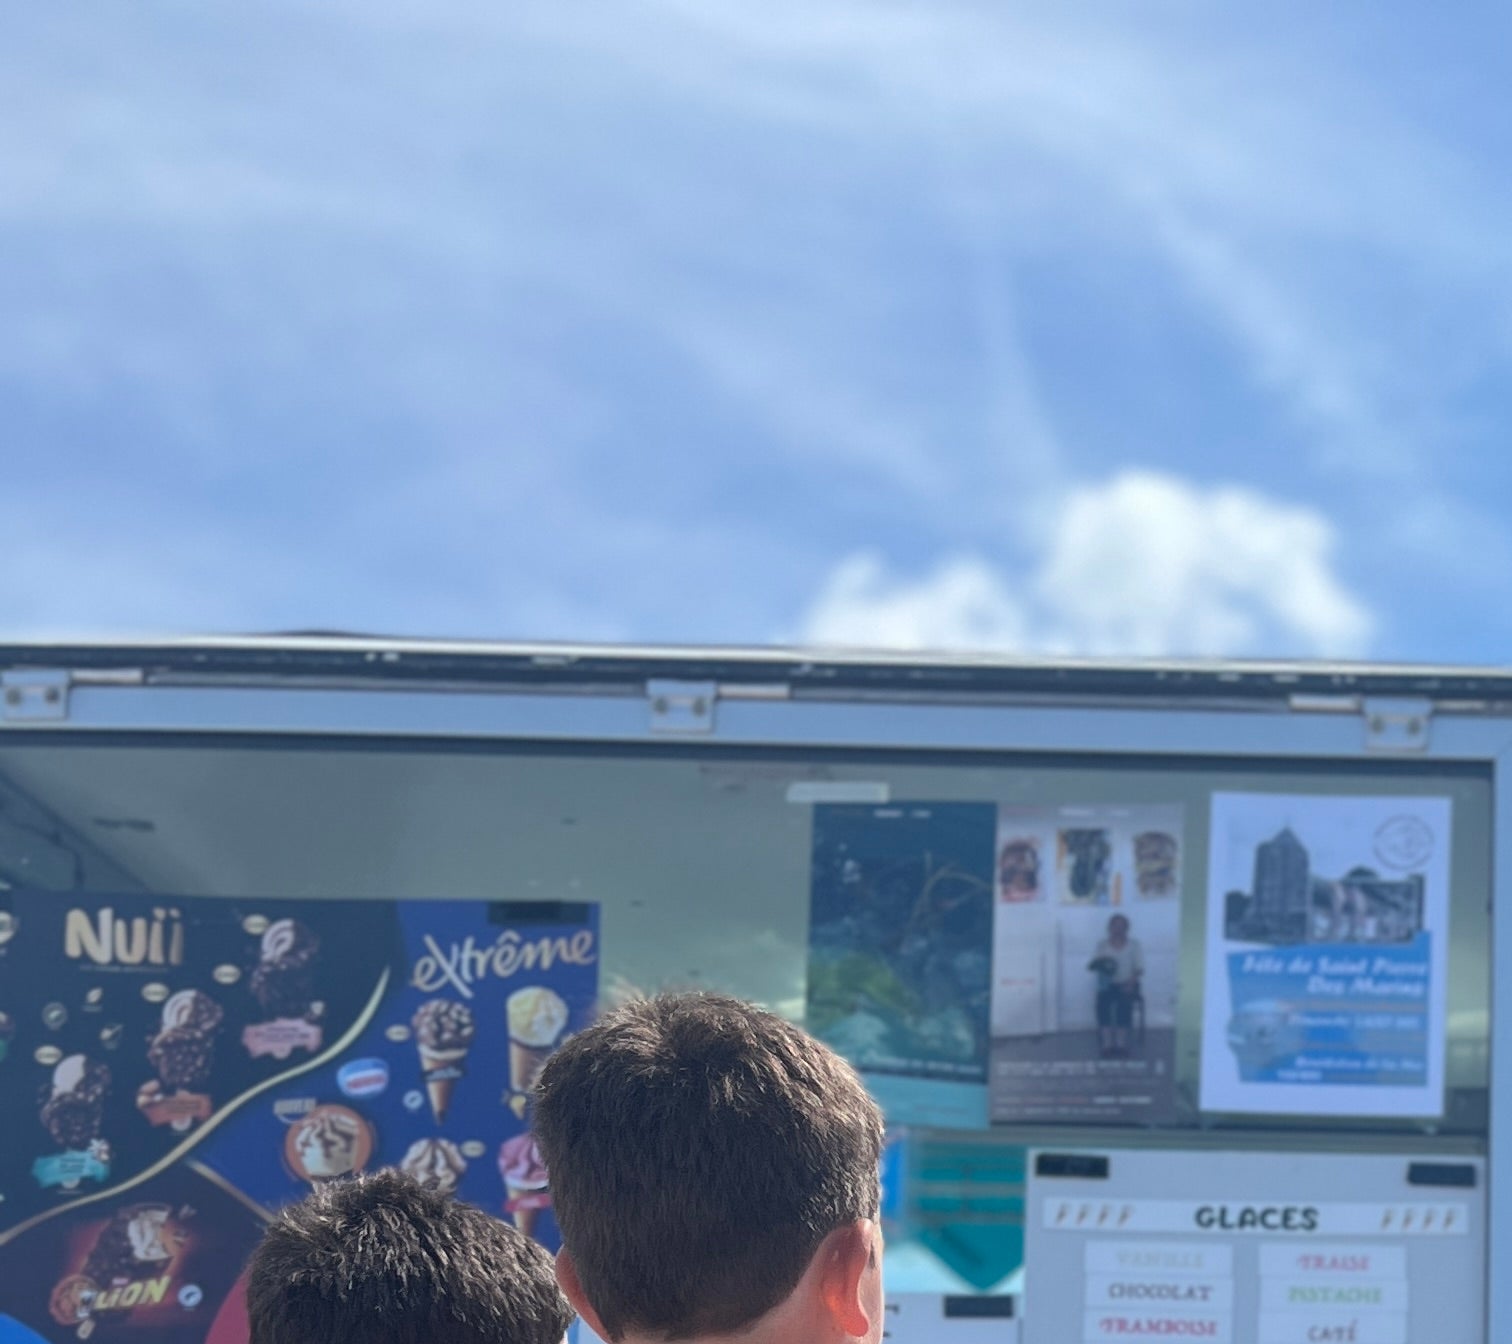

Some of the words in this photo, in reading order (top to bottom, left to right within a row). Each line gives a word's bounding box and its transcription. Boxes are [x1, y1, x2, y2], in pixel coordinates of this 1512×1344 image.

[1194, 1206, 1319, 1230] GLACES
[1108, 1282, 1213, 1301] CHOCOLAT
[1100, 1316, 1217, 1336] FRAMBOISE
